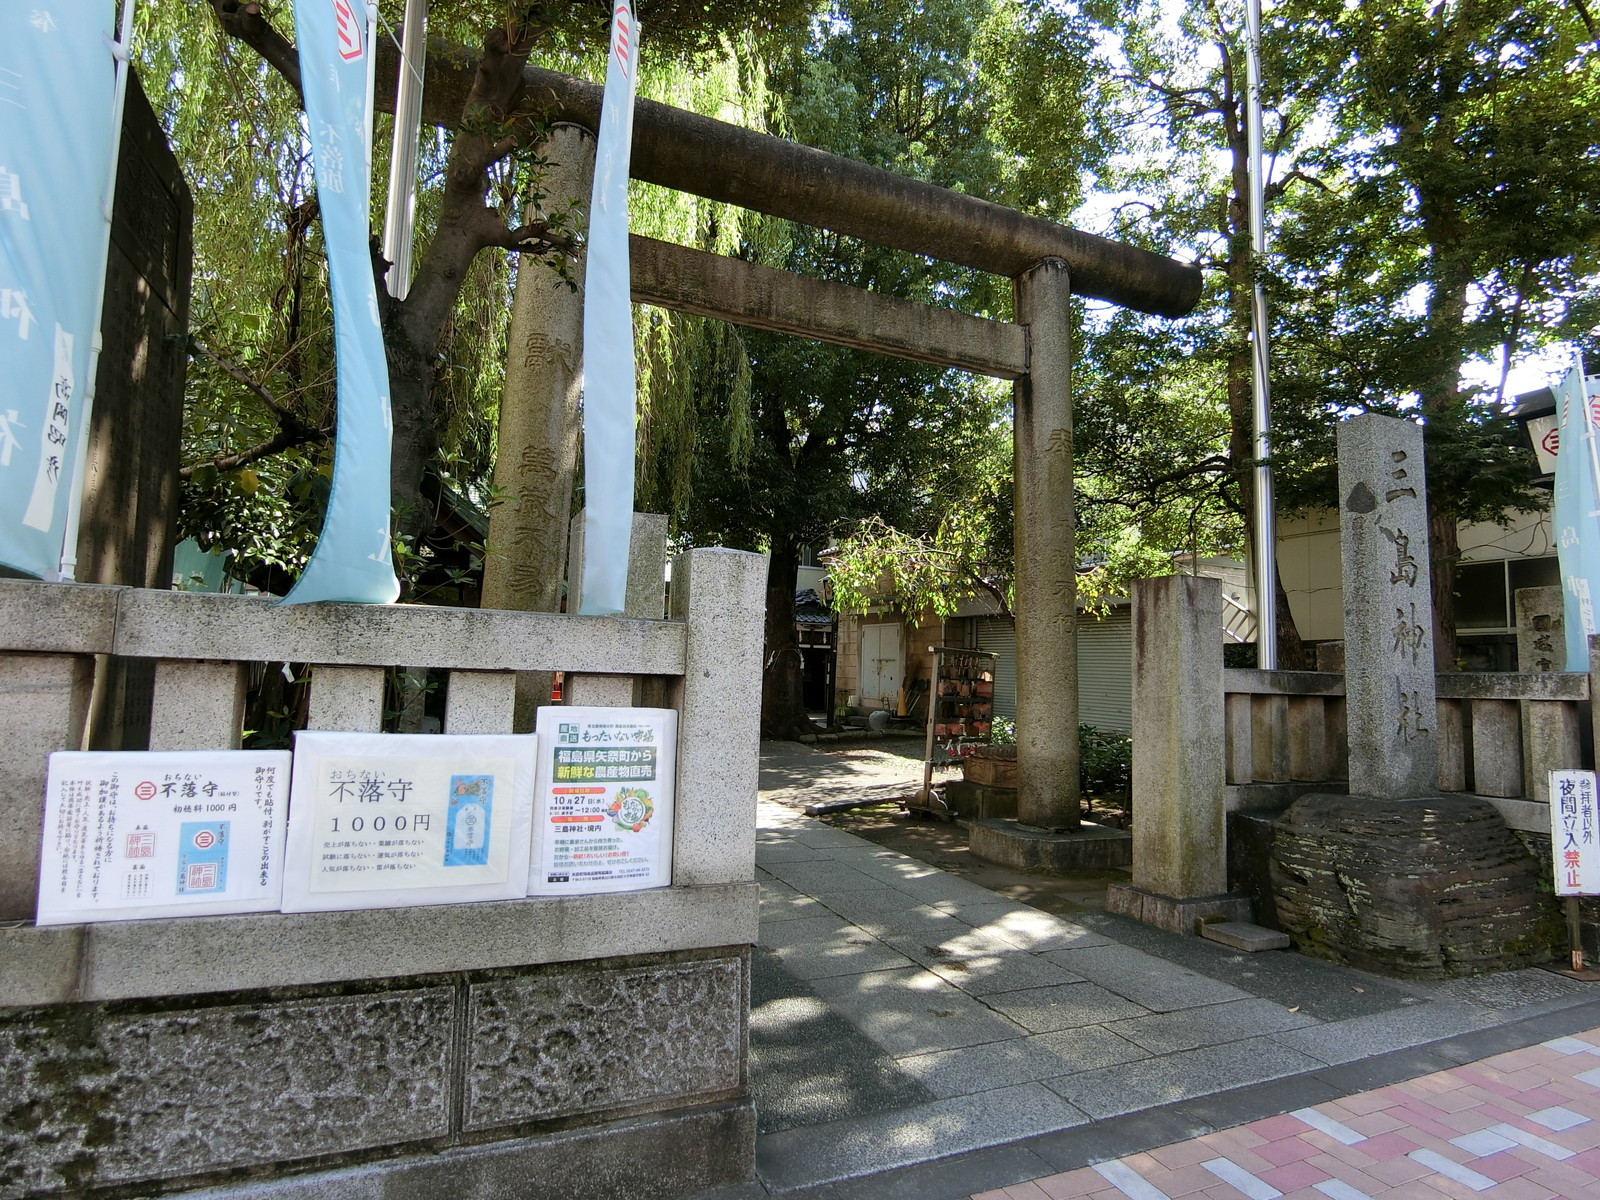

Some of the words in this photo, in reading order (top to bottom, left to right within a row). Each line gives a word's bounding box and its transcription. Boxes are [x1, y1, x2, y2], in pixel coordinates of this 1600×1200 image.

[1385, 450, 1430, 746] 三島神社
[582, 729, 654, 742] もったいない市場
[558, 750, 652, 763] 福島県矢祭町から
[330, 770, 386, 780] おちない
[557, 765, 652, 779] 新鮮な農産物直売
[160, 781, 218, 798] 不落守
[254, 766, 265, 809] 御守りです。
[328, 778, 414, 803] 不落守
[206, 804, 225, 812] 1000
[228, 804, 237, 812] 円
[1579, 778, 1594, 844] 参拝者以外
[1560, 778, 1582, 888] 夜間立入禁止
[323, 840, 425, 848] 売上が落ちない・業績が落ちない
[322, 852, 424, 860] 試験に落ちない・運気が落ちない
